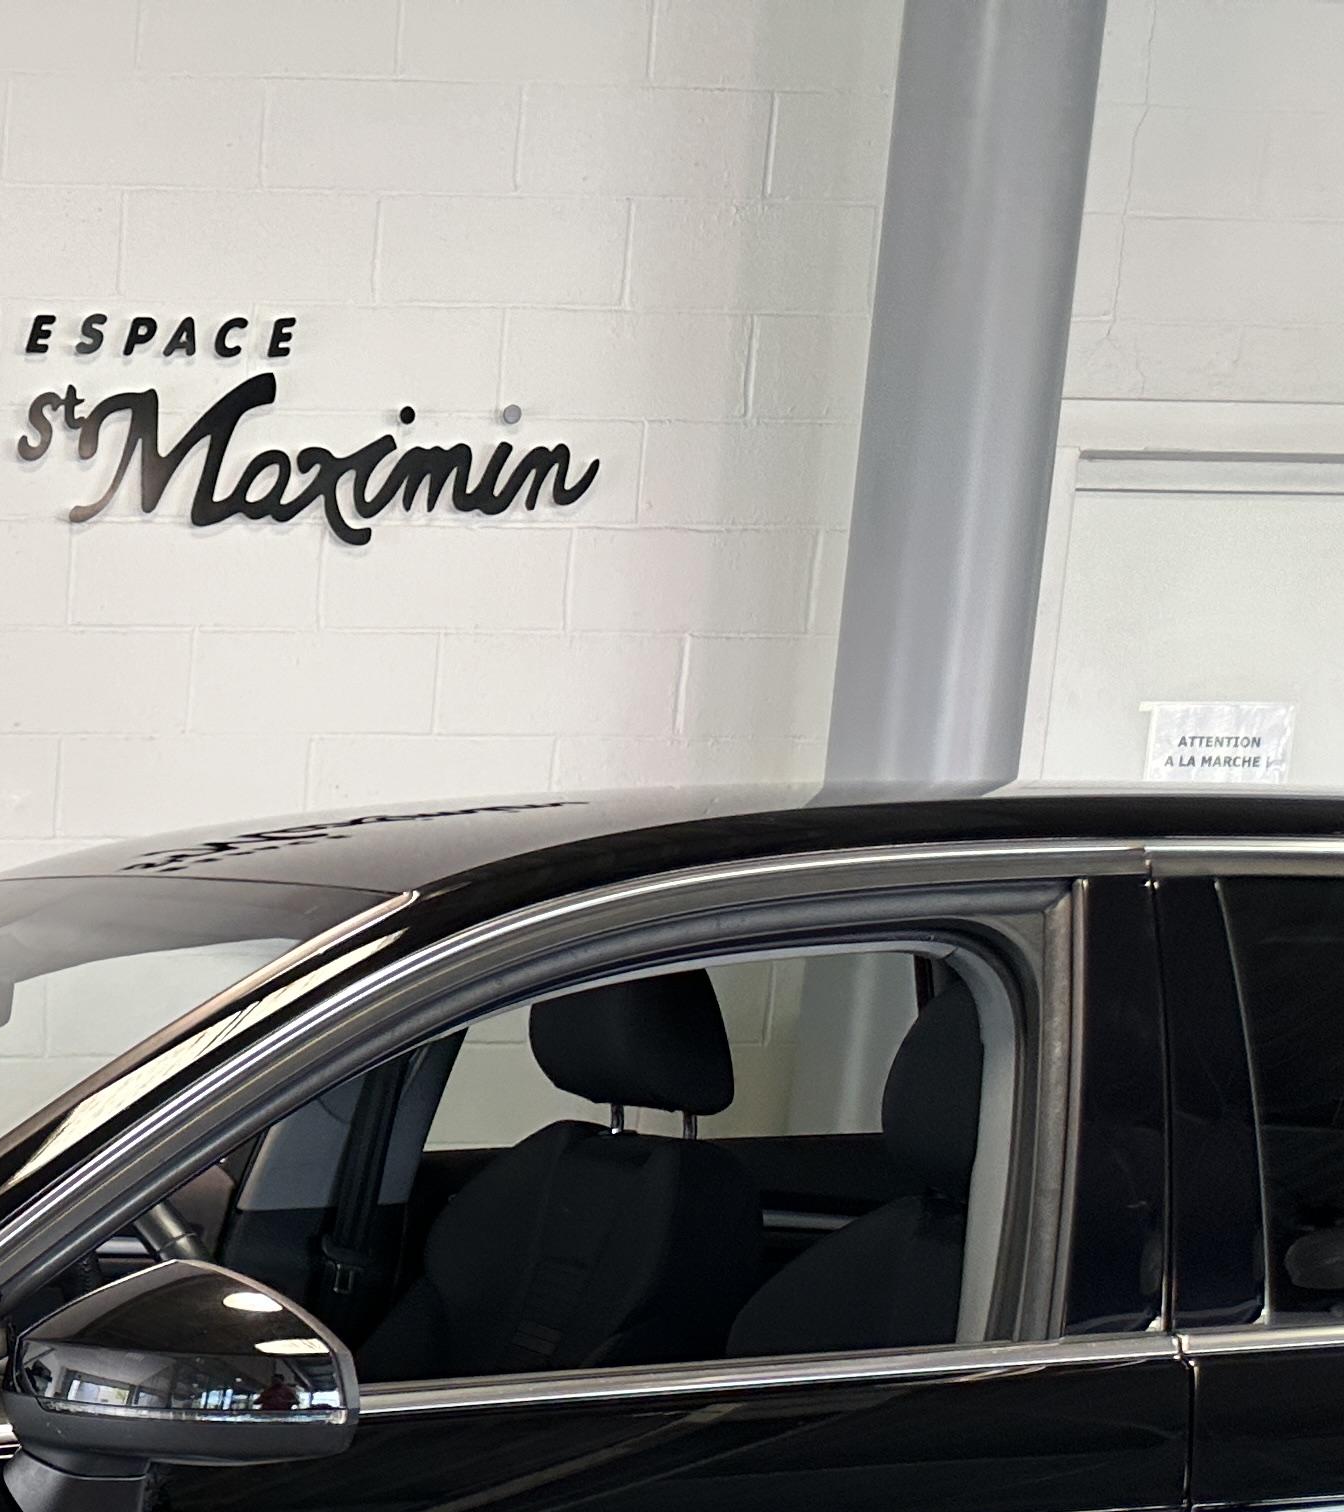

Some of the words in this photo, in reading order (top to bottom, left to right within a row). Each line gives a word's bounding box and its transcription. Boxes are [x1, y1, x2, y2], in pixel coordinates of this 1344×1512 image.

[24, 313, 297, 358] ESPACE
[17, 384, 86, 461] St
[68, 372, 601, 546] Maximin
[1177, 735, 1262, 749] ATTENTION
[1163, 755, 1175, 768] A
[1178, 755, 1196, 768] LA
[1200, 755, 1262, 769] MARCHE
